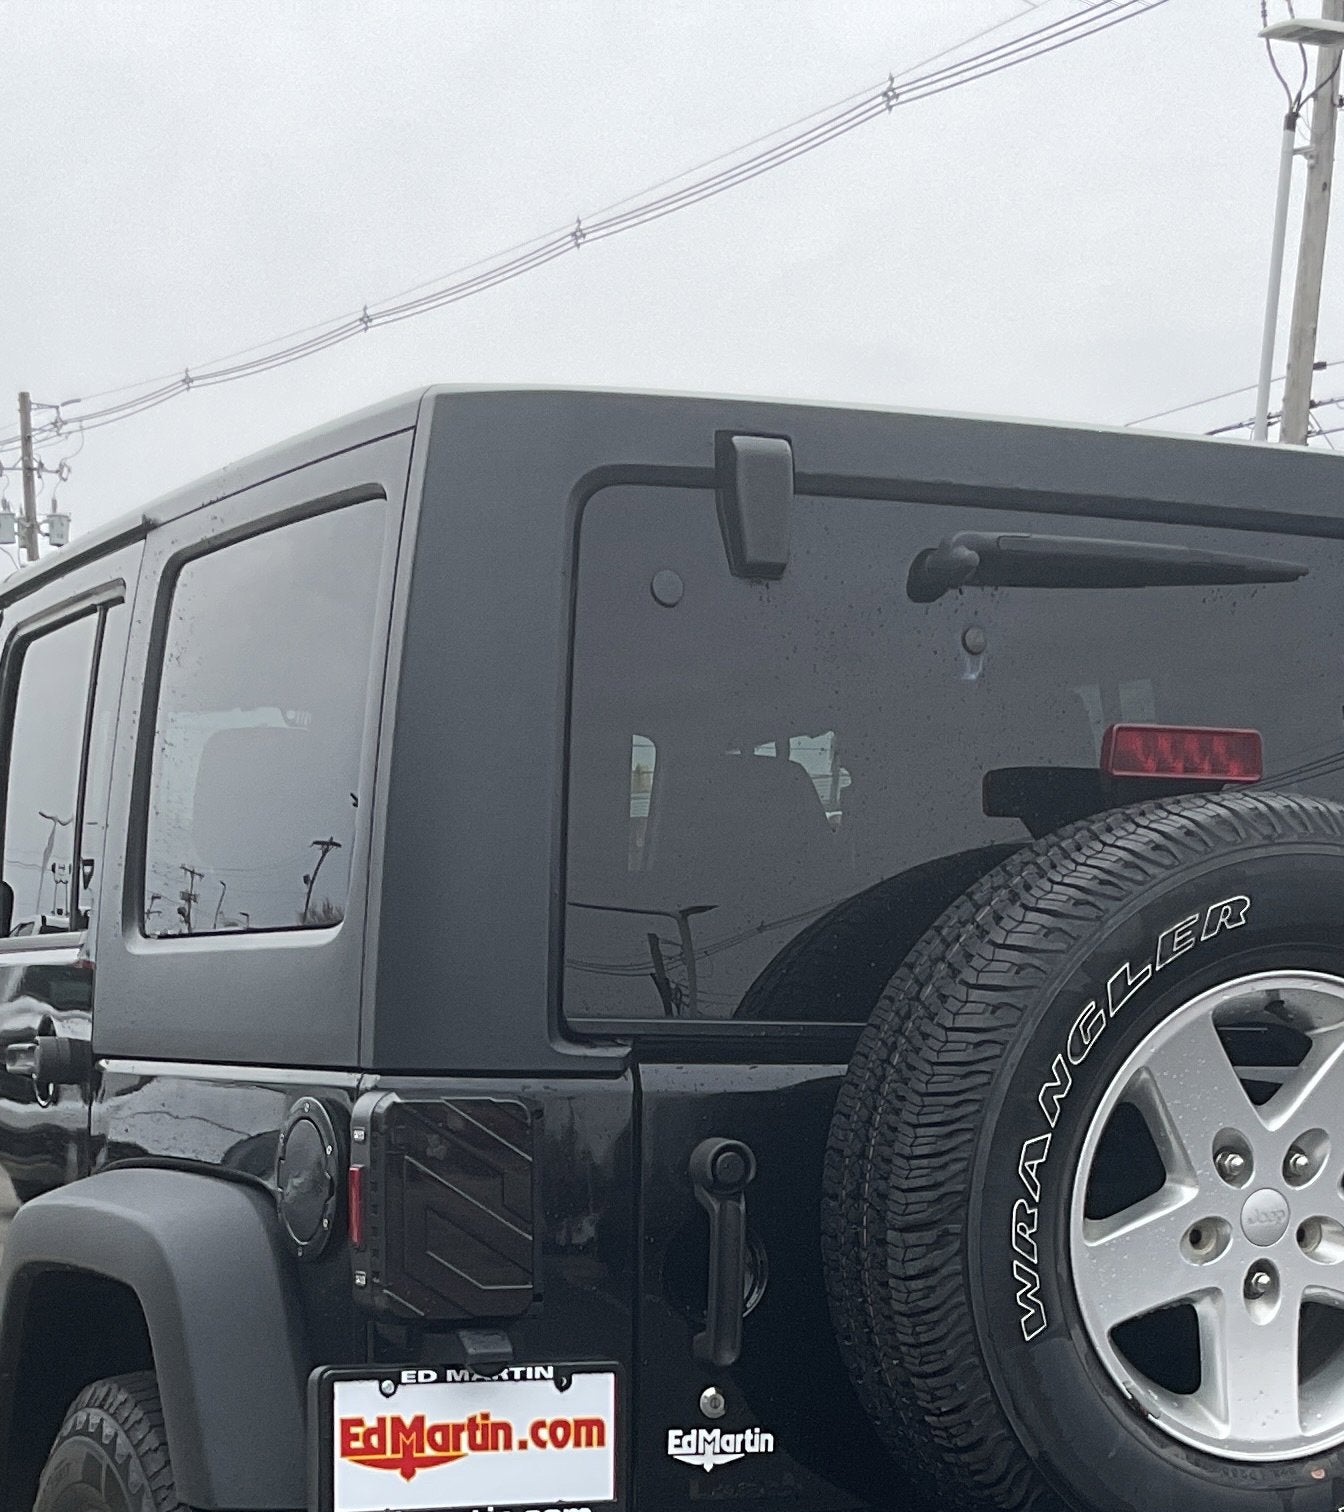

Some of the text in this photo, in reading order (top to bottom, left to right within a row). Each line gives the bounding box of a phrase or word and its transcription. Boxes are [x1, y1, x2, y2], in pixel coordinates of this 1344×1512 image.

[1011, 894, 1252, 1343] WRANGLER
[400, 1369, 437, 1384] ED
[338, 1411, 607, 1468] EdMartin.com
[666, 1426, 775, 1464] EdMartin
